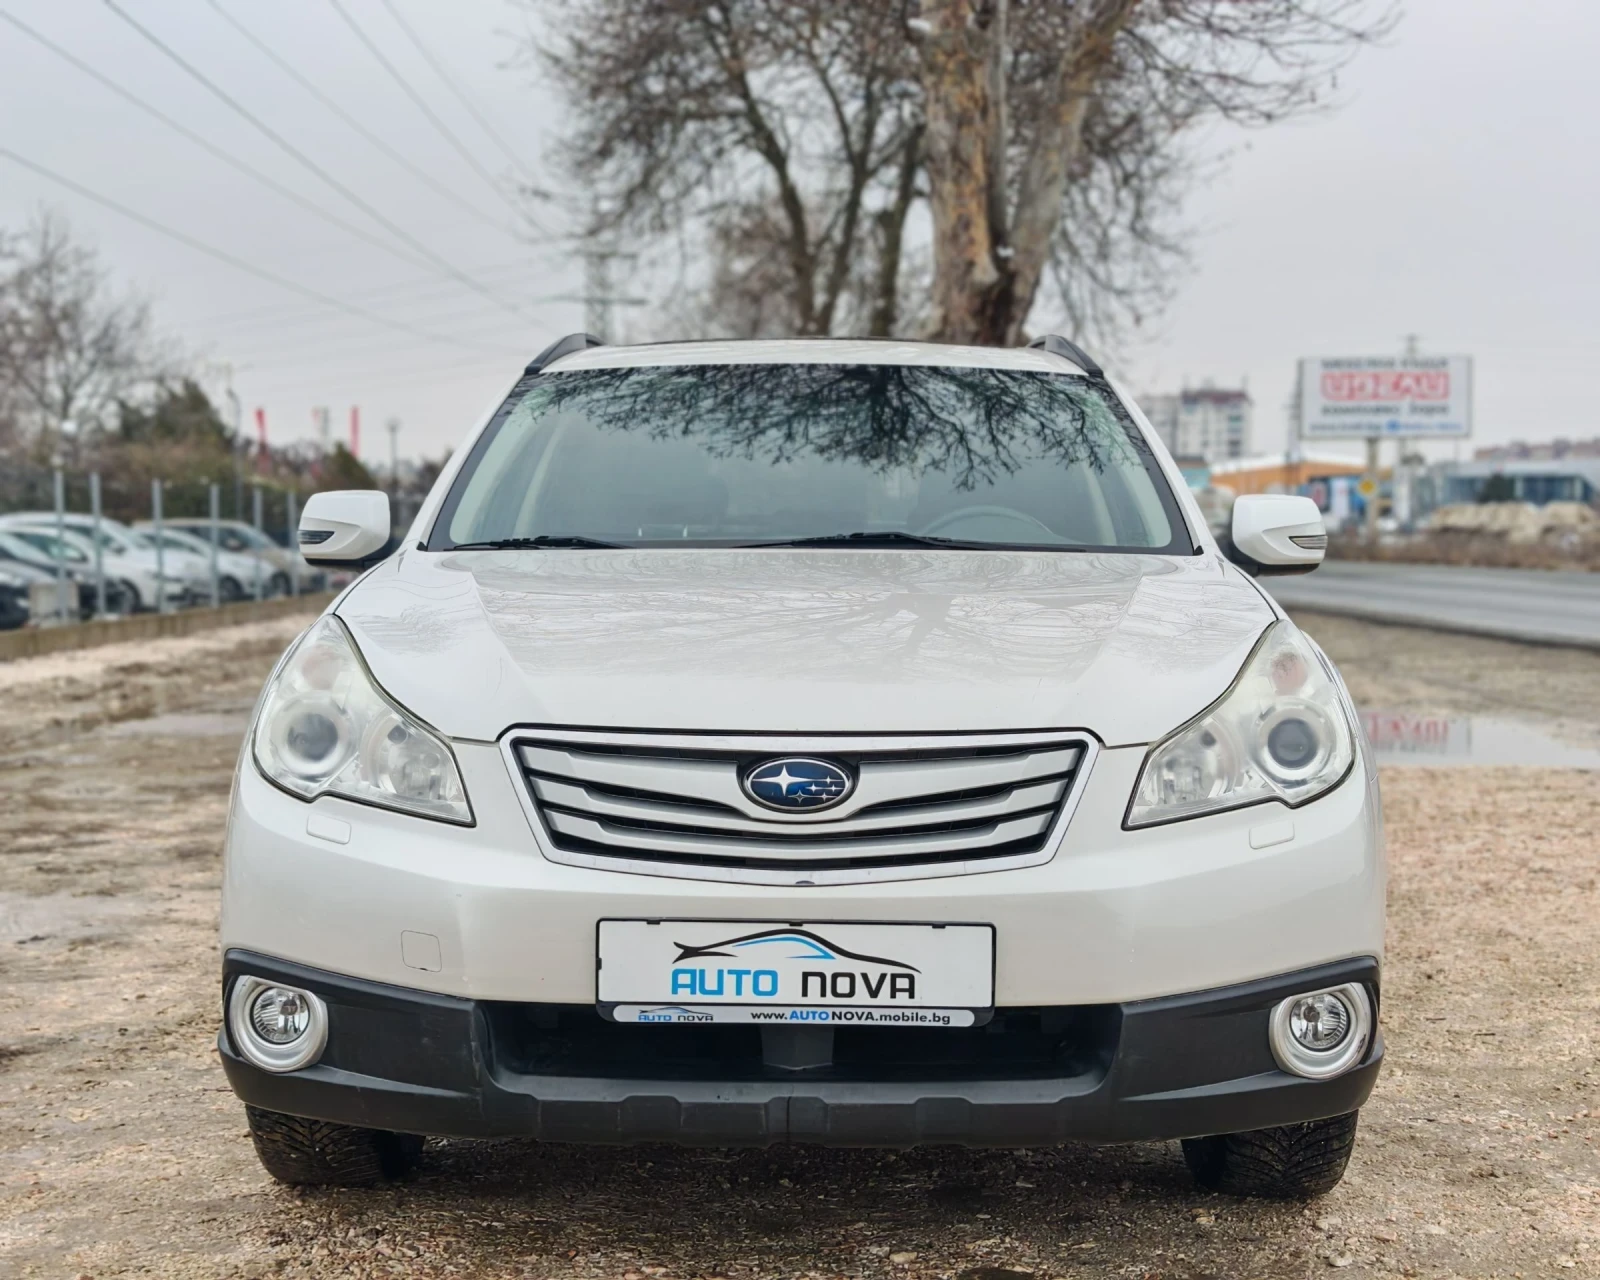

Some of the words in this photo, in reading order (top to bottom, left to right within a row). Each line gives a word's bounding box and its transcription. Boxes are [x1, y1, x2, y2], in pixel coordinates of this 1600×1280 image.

[671, 968, 778, 997] AUTO
[801, 971, 916, 999] NOVA
[638, 1014, 672, 1022] AUTO
